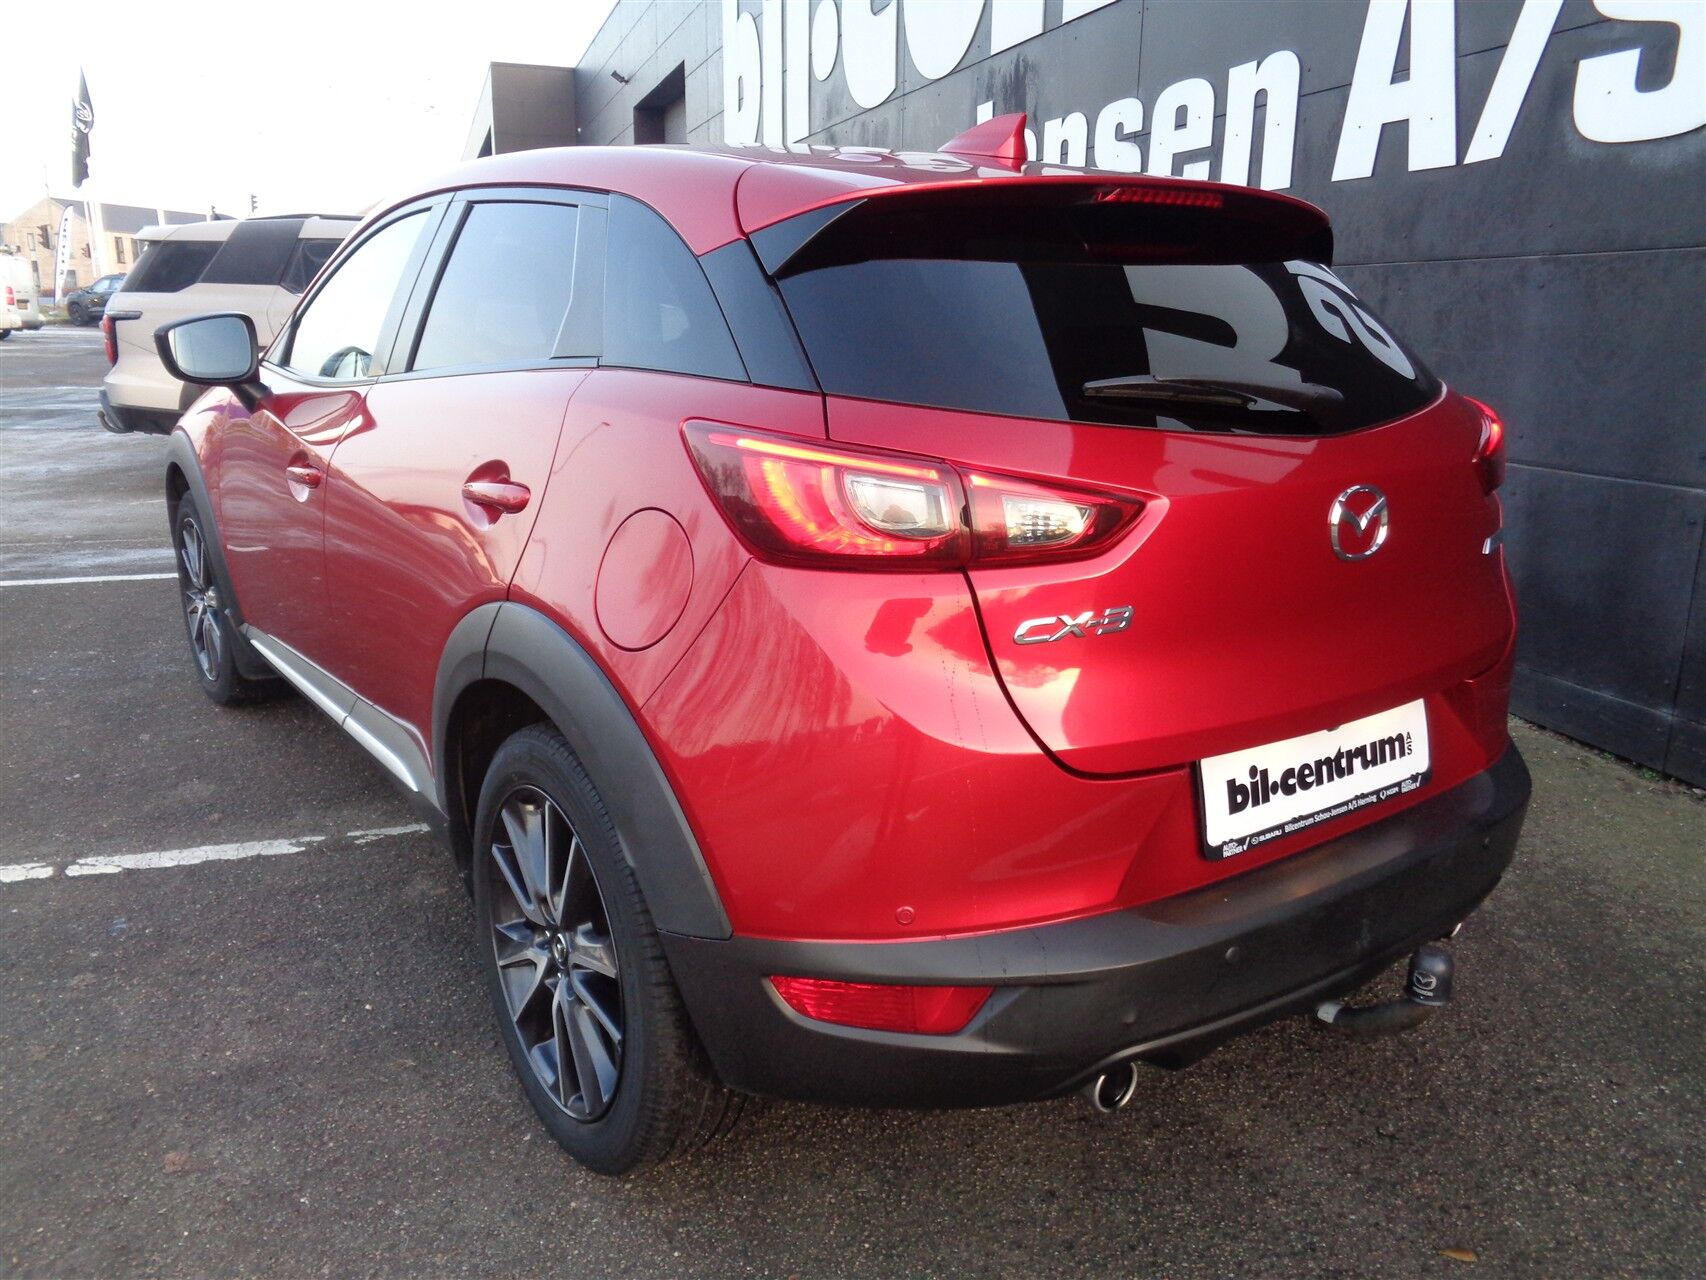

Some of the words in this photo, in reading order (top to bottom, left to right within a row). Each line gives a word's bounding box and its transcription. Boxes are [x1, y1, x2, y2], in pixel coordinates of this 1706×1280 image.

[1012, 605, 1135, 645] CX-3
[1284, 817, 1314, 833] Bilcentrum
[1347, 800, 1358, 811] A/S
[1258, 829, 1282, 842] SUBARU
